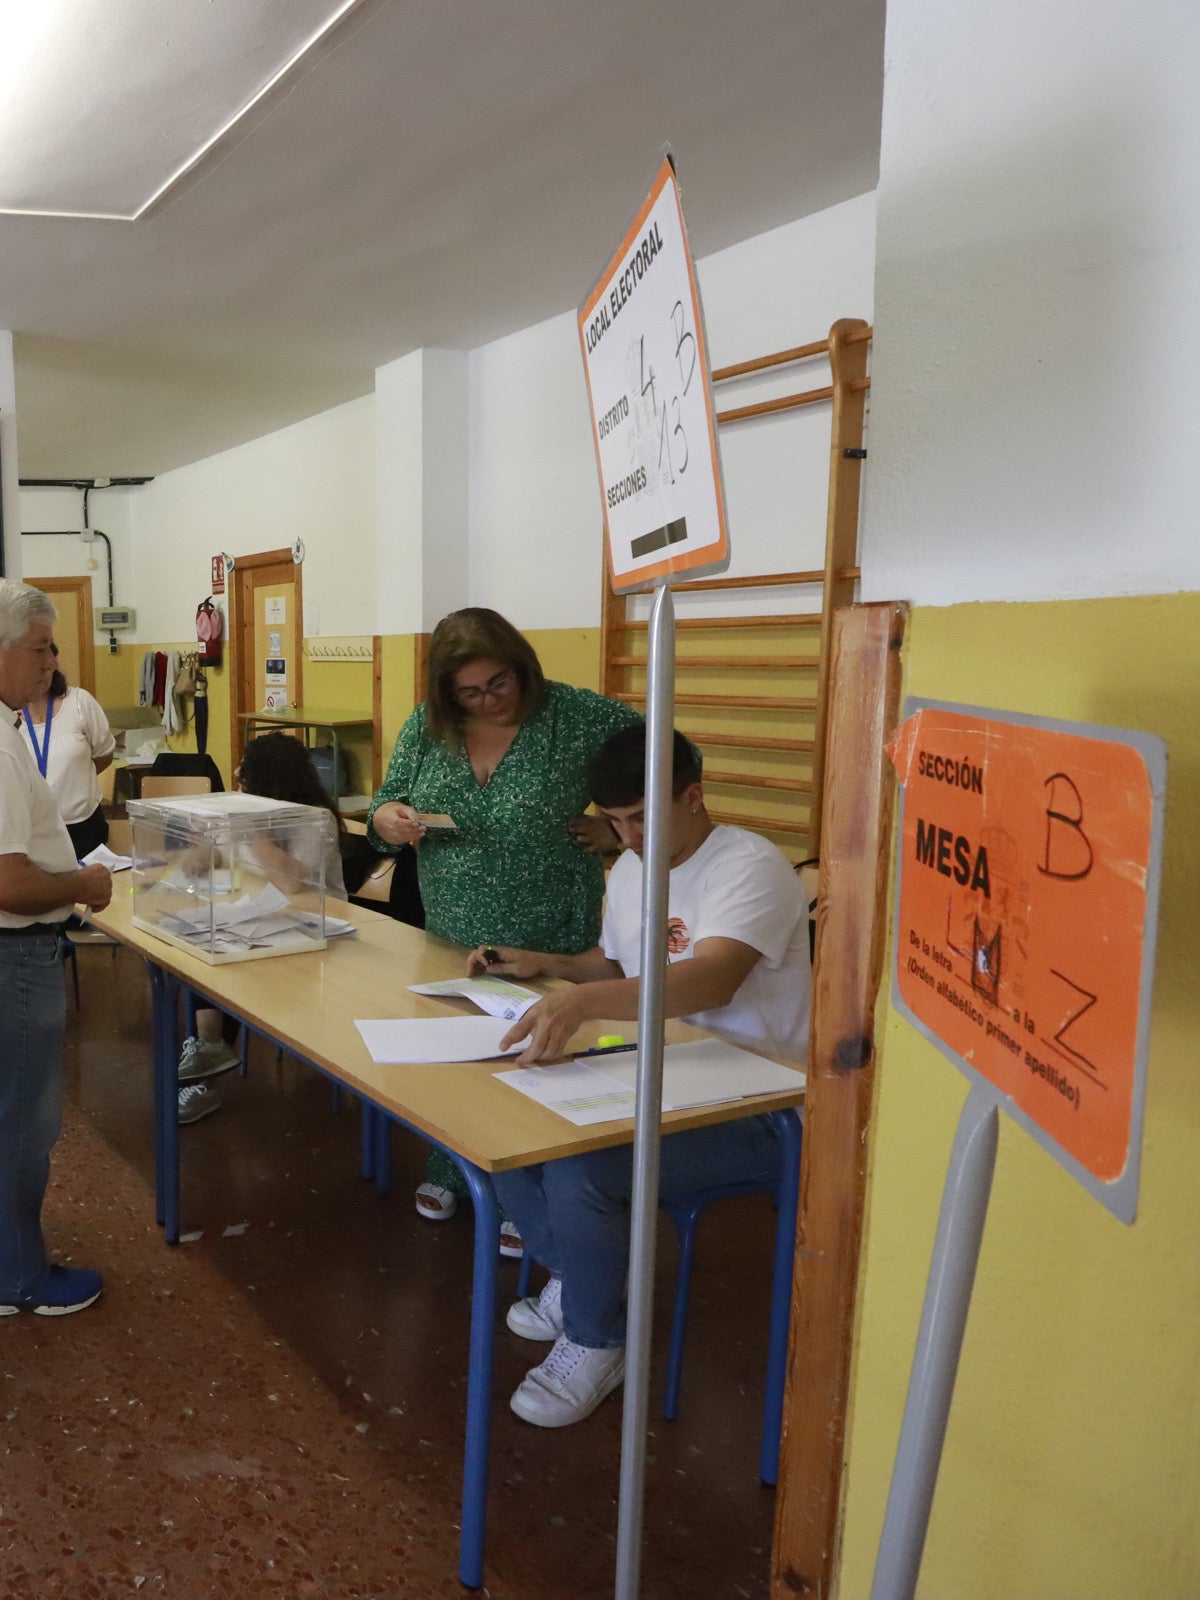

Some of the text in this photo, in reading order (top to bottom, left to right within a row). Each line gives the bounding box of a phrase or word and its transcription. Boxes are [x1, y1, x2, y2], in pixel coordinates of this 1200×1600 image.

[585, 221, 664, 354] LOCAL ELECTORAL
[598, 394, 629, 440] DISTRITO
[640, 334, 656, 418] 4
[607, 465, 647, 509] SECCIONES
[918, 750, 984, 795] SECCIÓN
[915, 818, 991, 899] MESA
[1037, 772, 1094, 882] B
[909, 929, 1036, 1035] De la letra a la
[1050, 967, 1098, 1071] Z
[907, 956, 1081, 1111] (Orden alfabético primer apellido)
